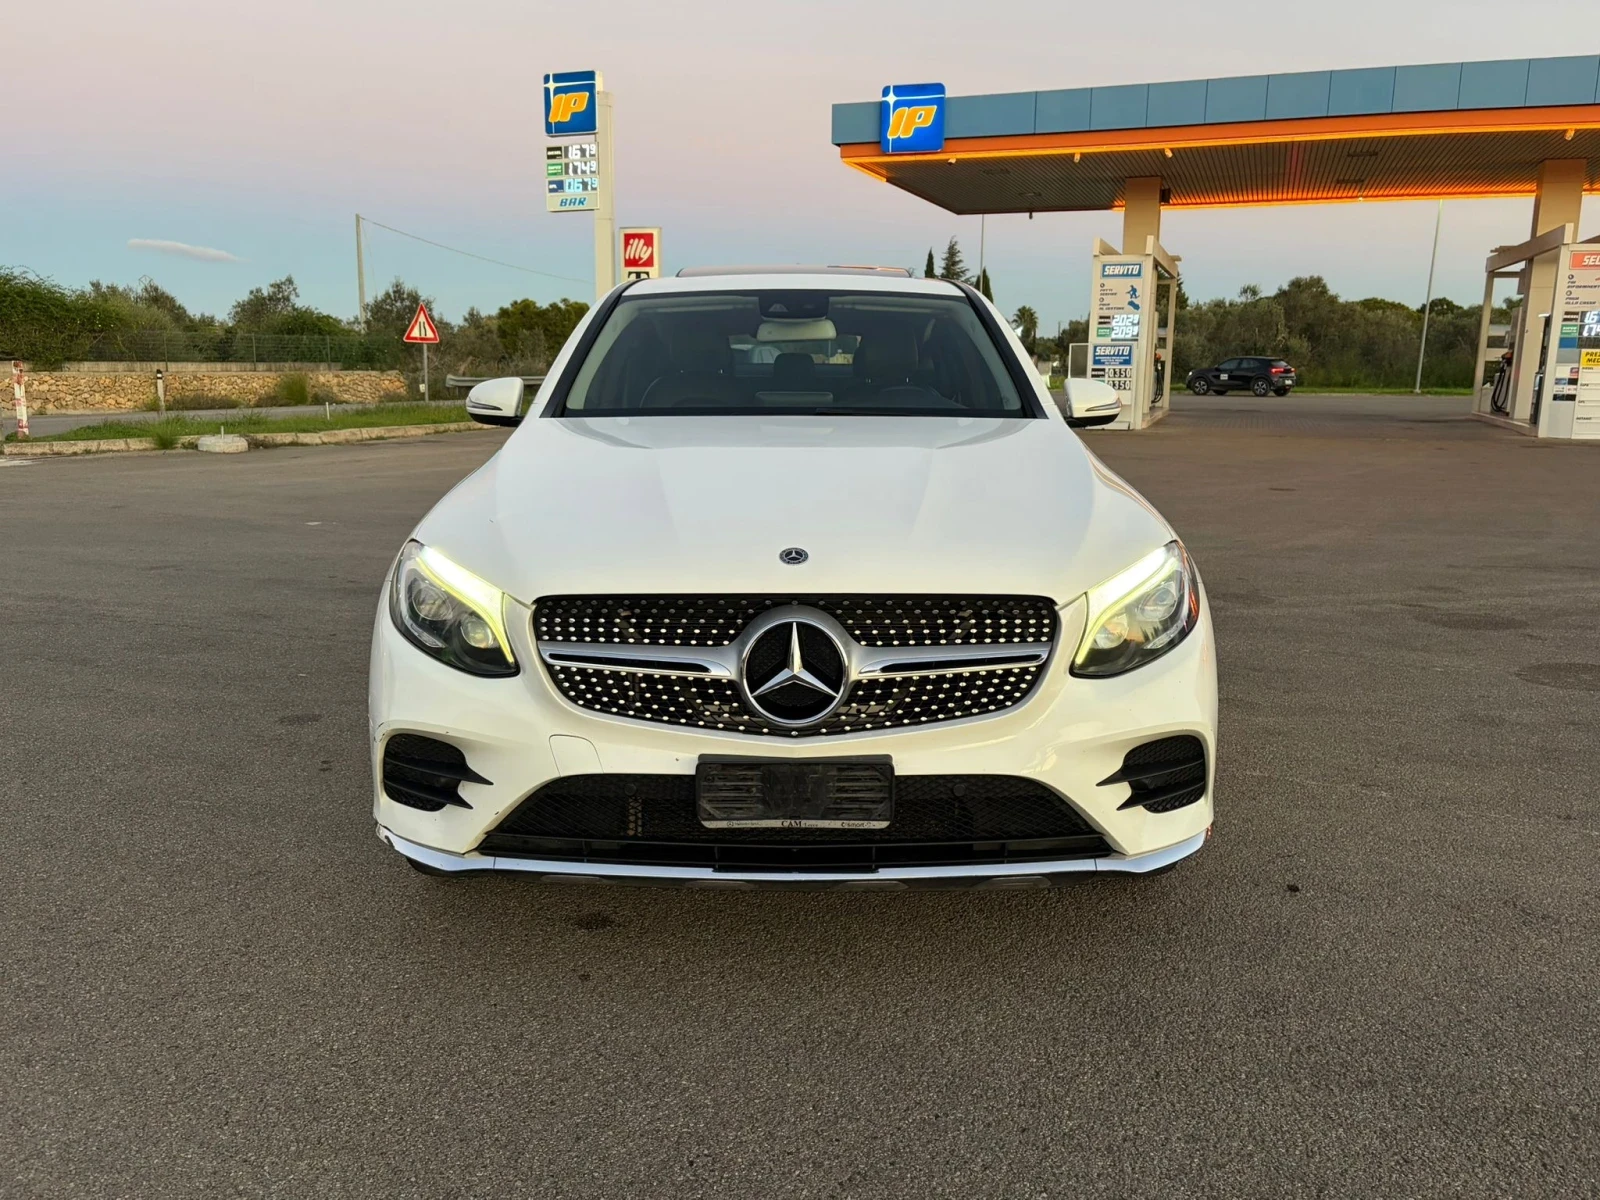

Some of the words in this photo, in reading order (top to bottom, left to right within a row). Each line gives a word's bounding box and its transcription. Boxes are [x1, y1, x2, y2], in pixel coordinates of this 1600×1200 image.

[548, 92, 589, 123] IP
[887, 105, 937, 139] IP
[559, 197, 587, 207] BAR
[625, 237, 652, 264] illy
[1103, 265, 1140, 275] SERVITO
[1095, 346, 1130, 356] SERVITO
[781, 820, 802, 828] CAM
